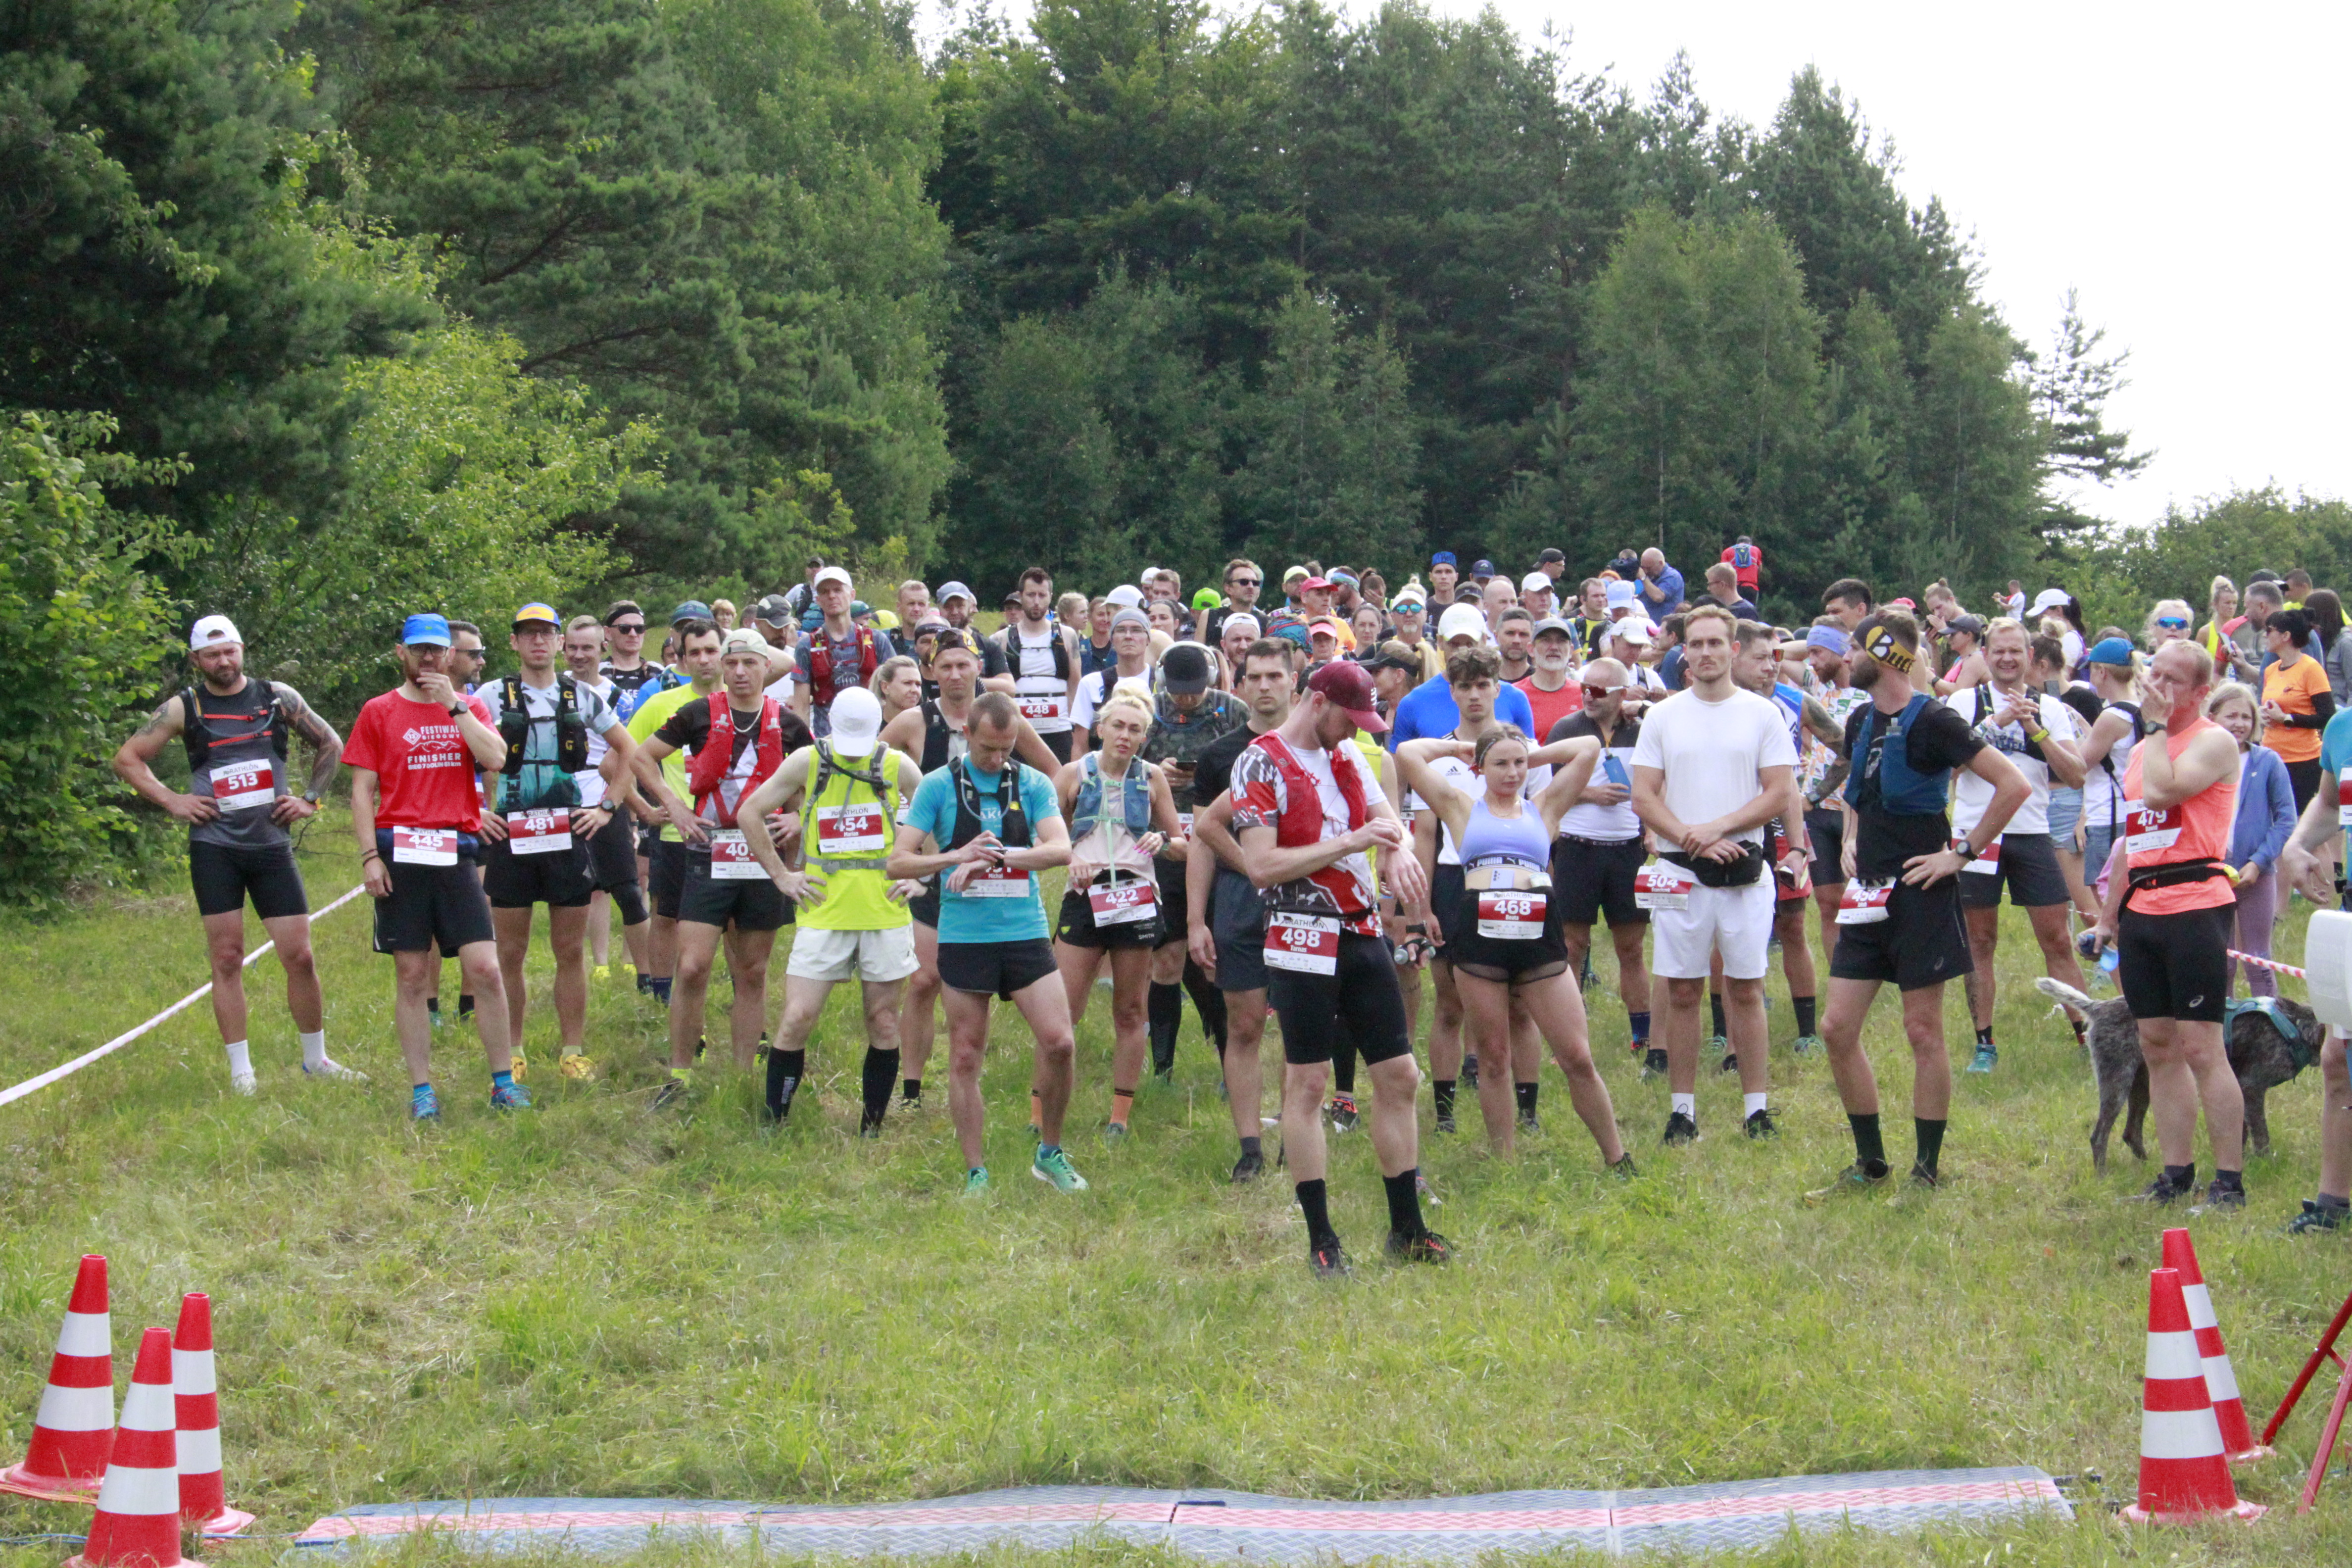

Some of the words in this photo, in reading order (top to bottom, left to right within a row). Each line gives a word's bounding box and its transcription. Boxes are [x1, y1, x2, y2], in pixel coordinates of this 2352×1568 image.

[1026, 705, 1049, 714] 448
[420, 725, 459, 735] FESTIWAL
[407, 752, 461, 764] FINISHER
[228, 772, 258, 790] 513
[525, 817, 554, 831] 481
[833, 816, 868, 832] 454
[2137, 810, 2166, 826] 479
[408, 834, 443, 847] 445
[726, 843, 754, 856] 40
[1647, 875, 1678, 887] 504
[1105, 889, 1138, 904] 422
[1852, 889, 1881, 902] 458
[1494, 900, 1531, 915] 468
[1281, 928, 1321, 947] 498
